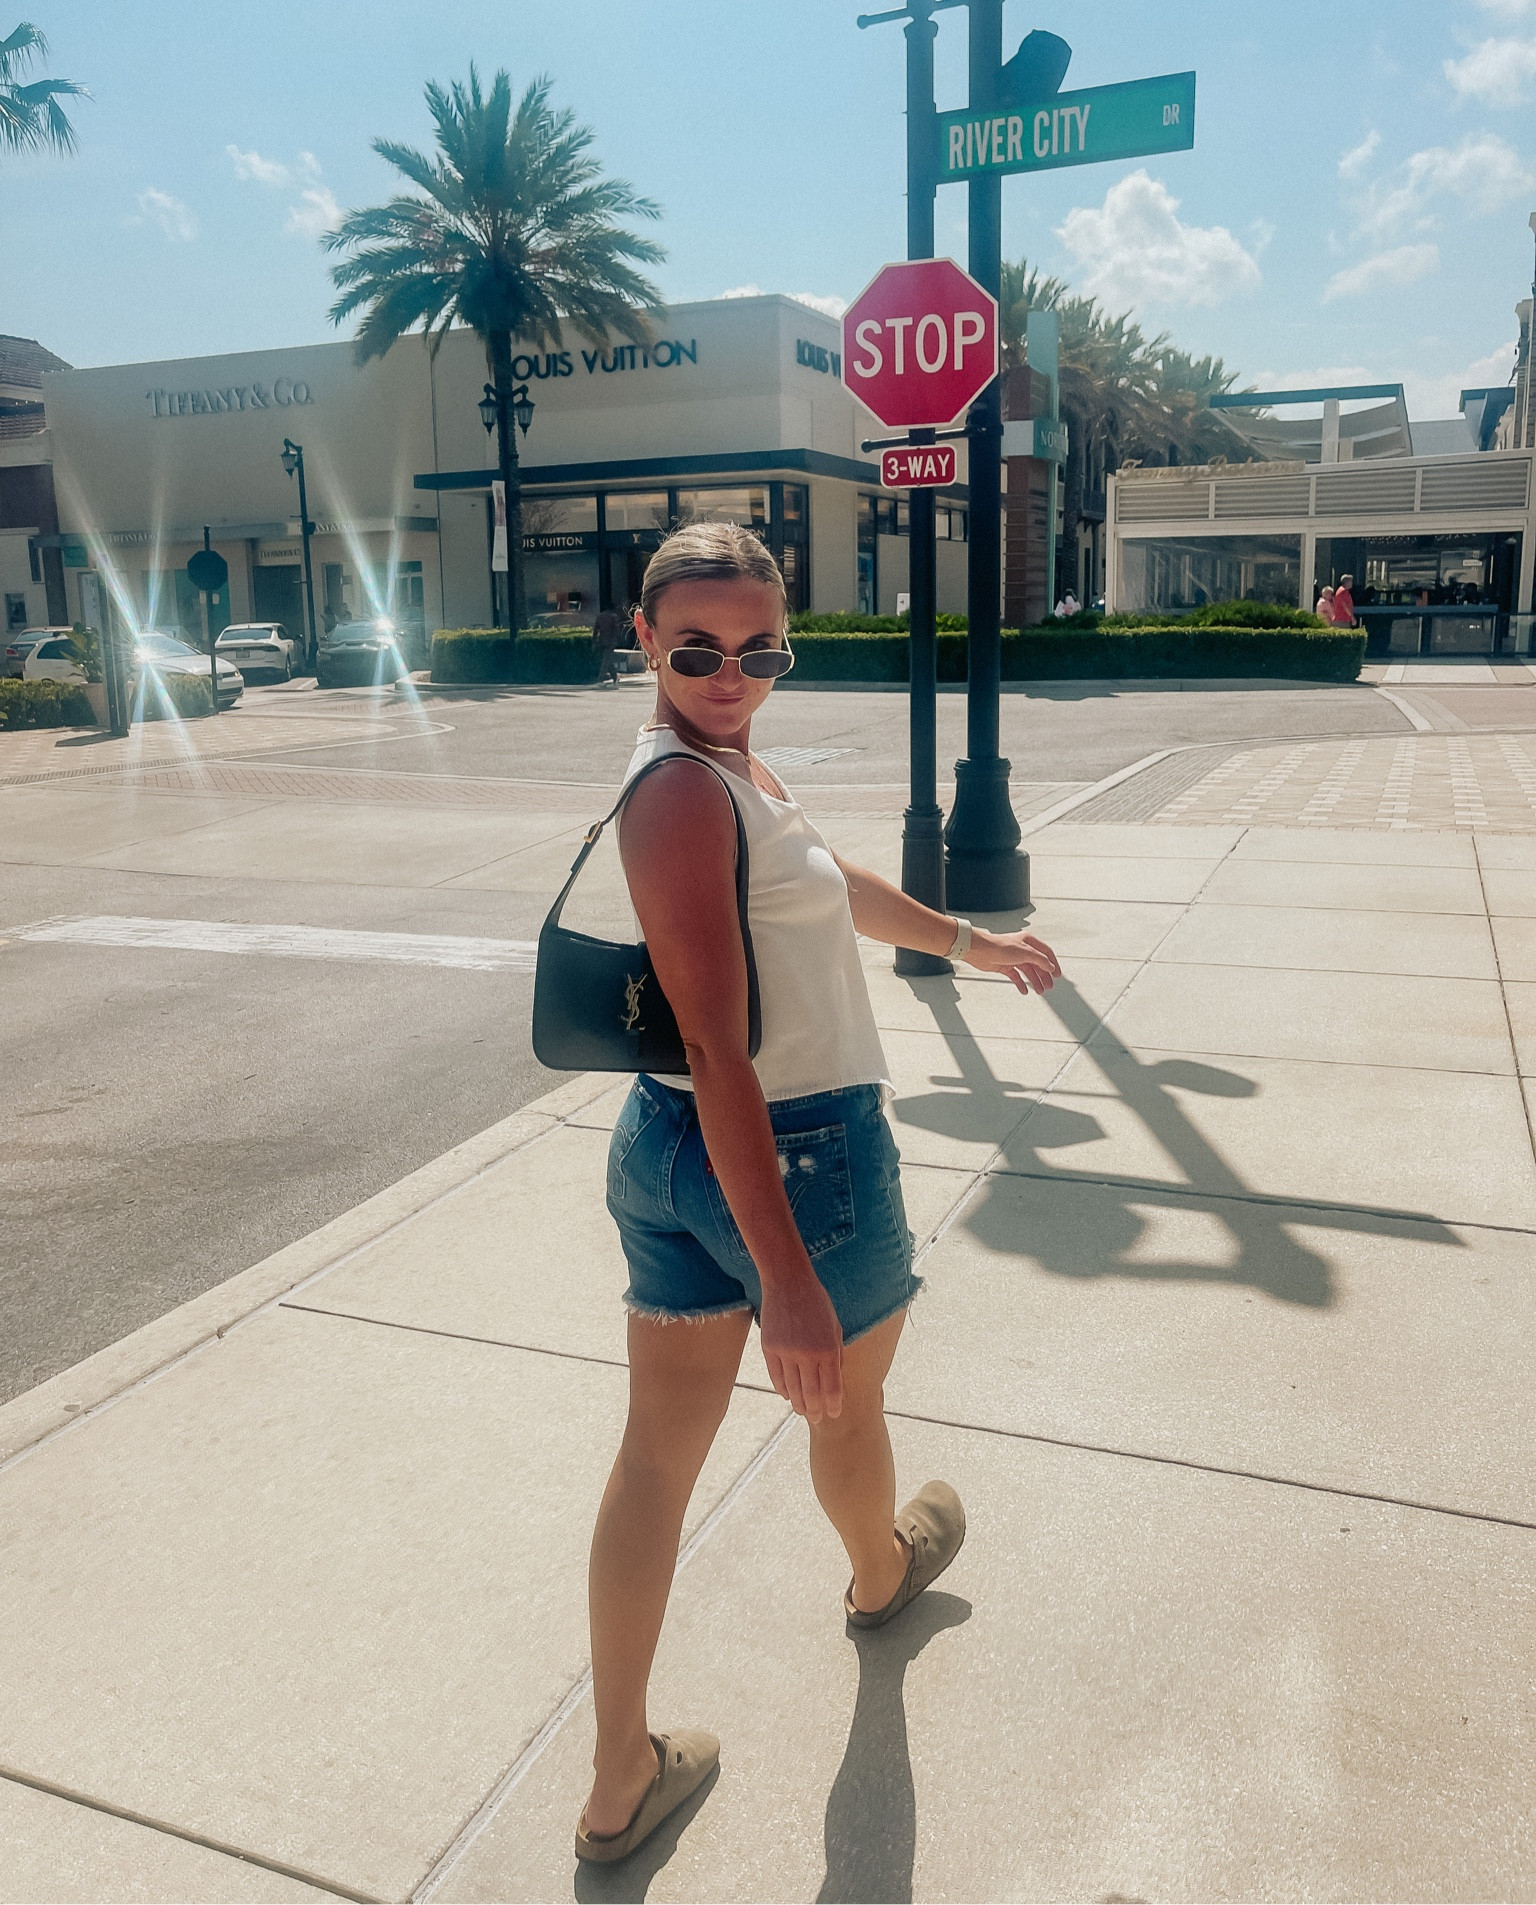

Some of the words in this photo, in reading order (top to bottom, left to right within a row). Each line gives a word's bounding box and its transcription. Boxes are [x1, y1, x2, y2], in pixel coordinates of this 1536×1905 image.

[949, 115, 1023, 170] RIVER
[1033, 104, 1091, 158] CITY
[1162, 103, 1180, 126] DR
[512, 351, 574, 382] OUIS
[581, 338, 698, 376] VUITTON
[853, 311, 986, 378] STOP
[886, 453, 951, 480] 3-WAY
[539, 535, 583, 548] VUITTON
